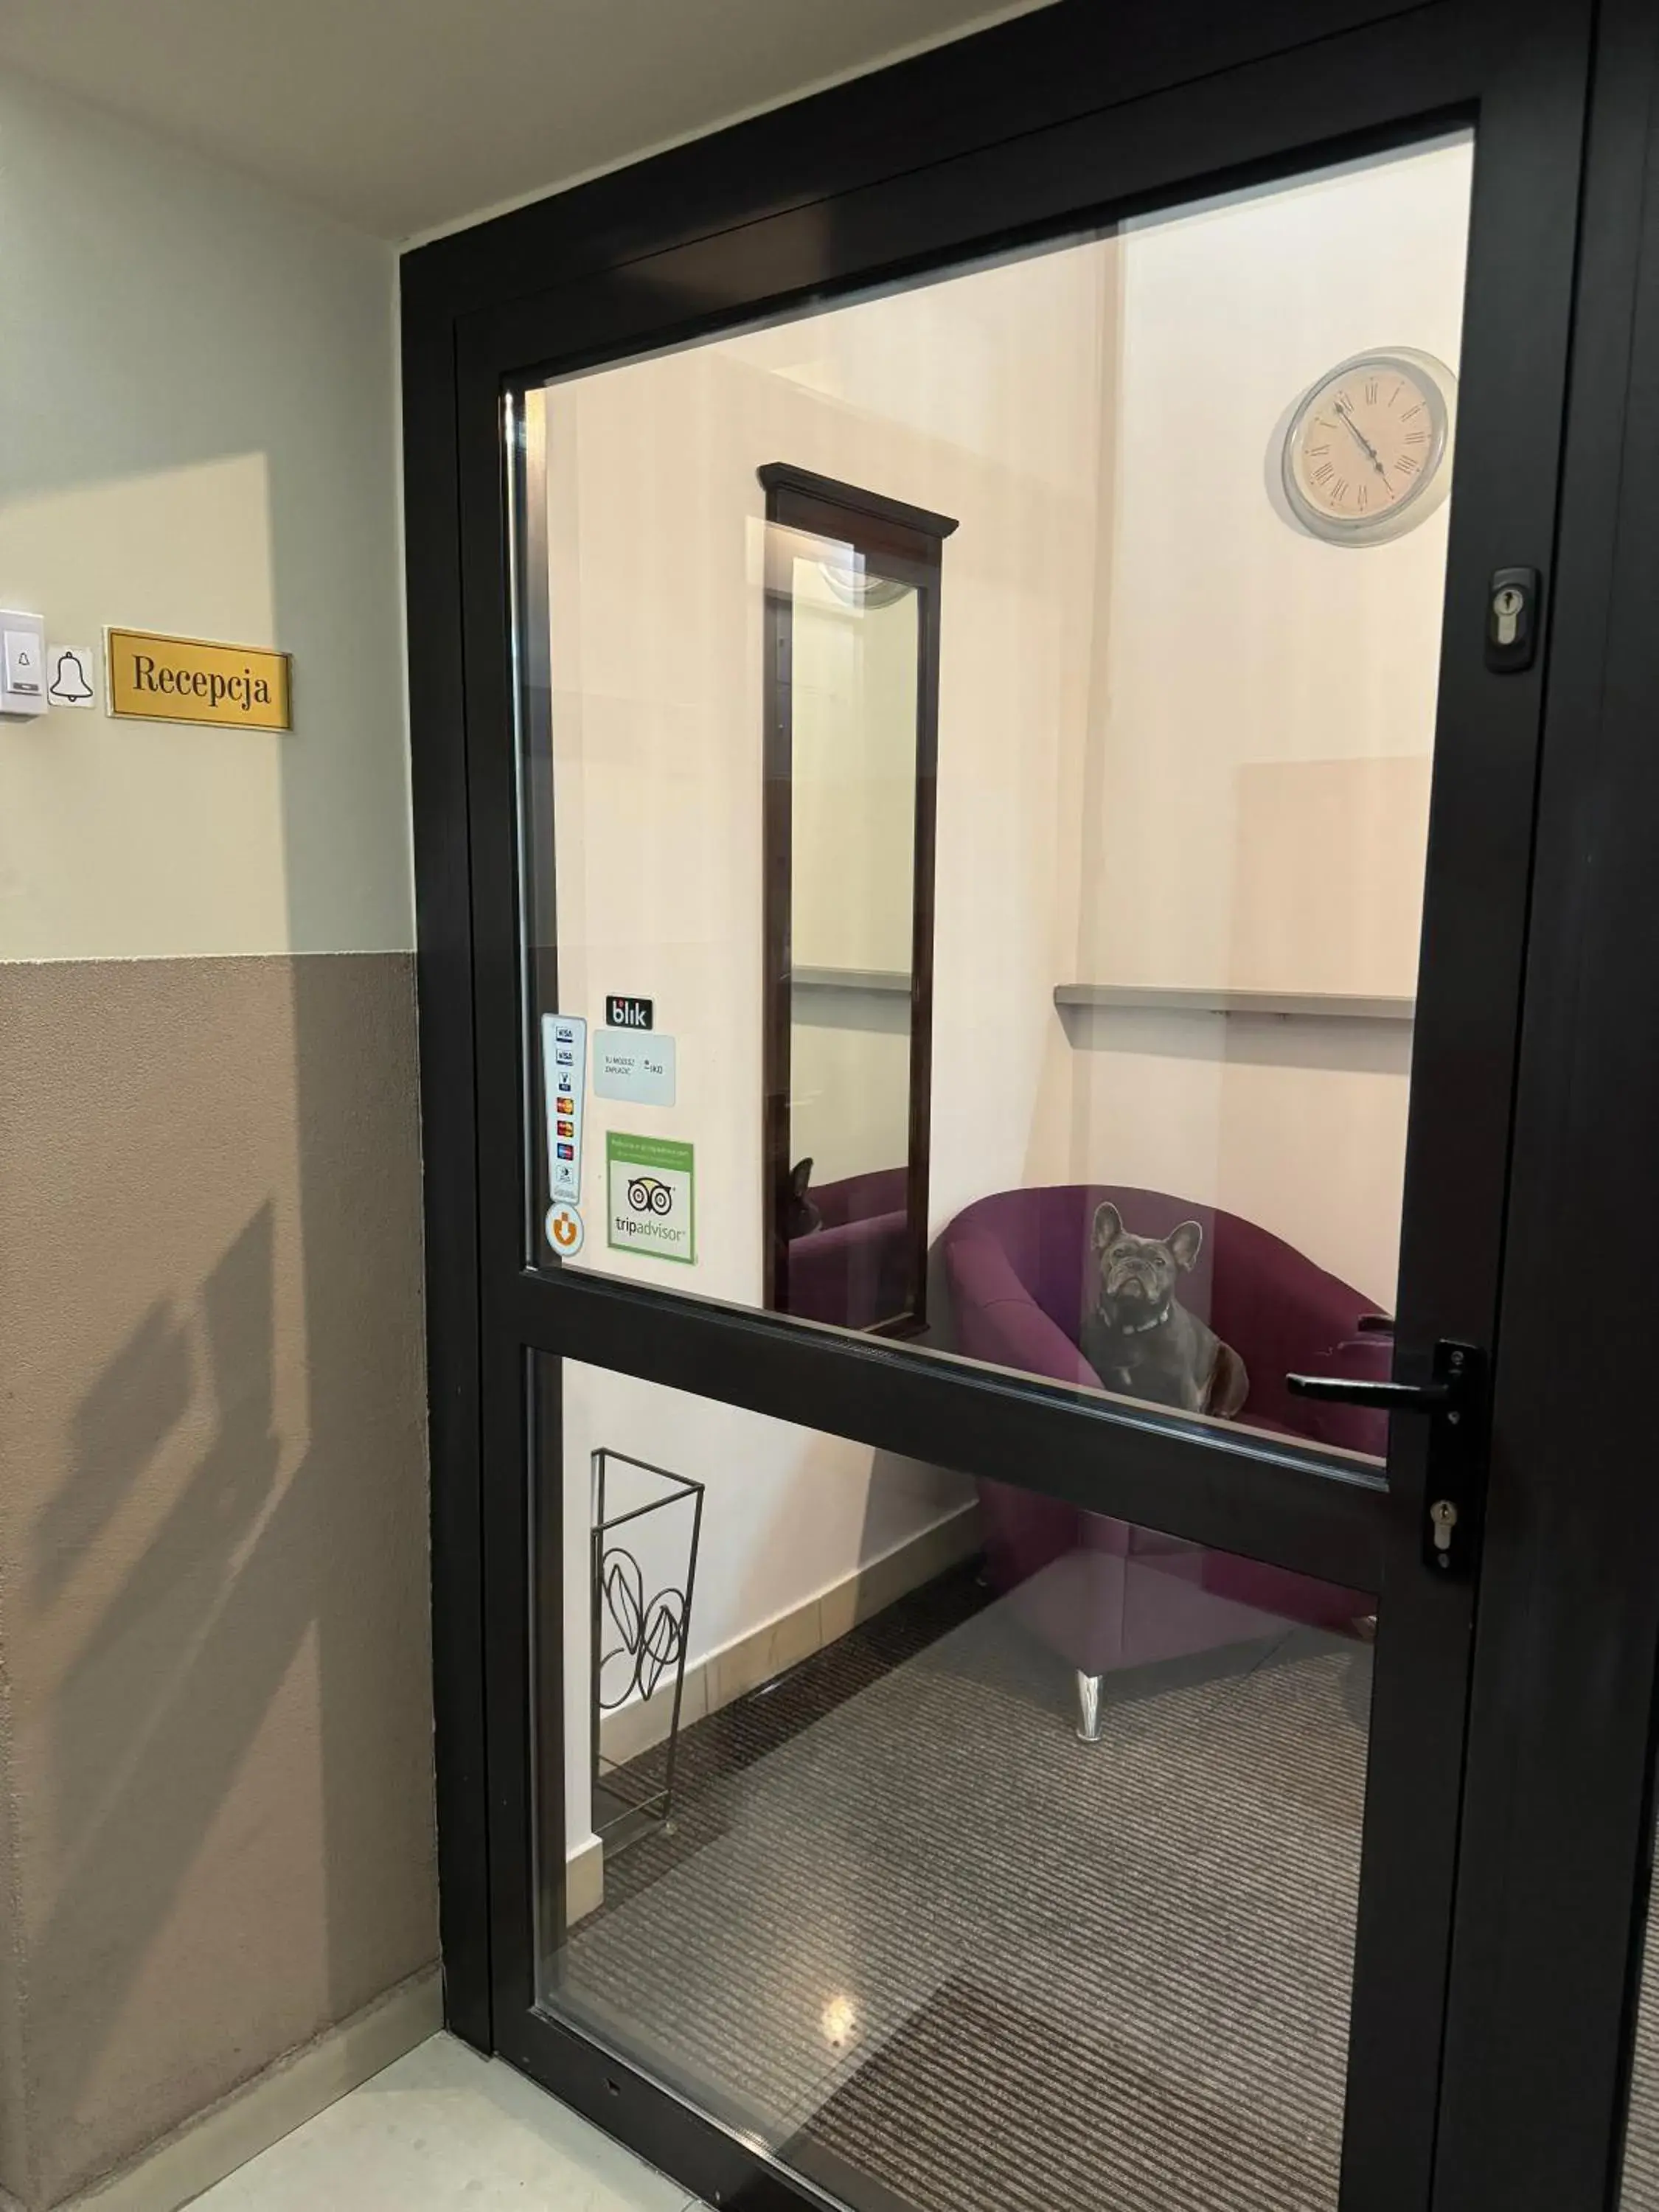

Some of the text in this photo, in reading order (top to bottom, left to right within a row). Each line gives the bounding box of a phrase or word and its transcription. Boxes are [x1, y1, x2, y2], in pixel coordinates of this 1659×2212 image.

[132, 653, 272, 711] Recepcja
[613, 998, 647, 1026] blik
[615, 1216, 683, 1242] tripadvisor
